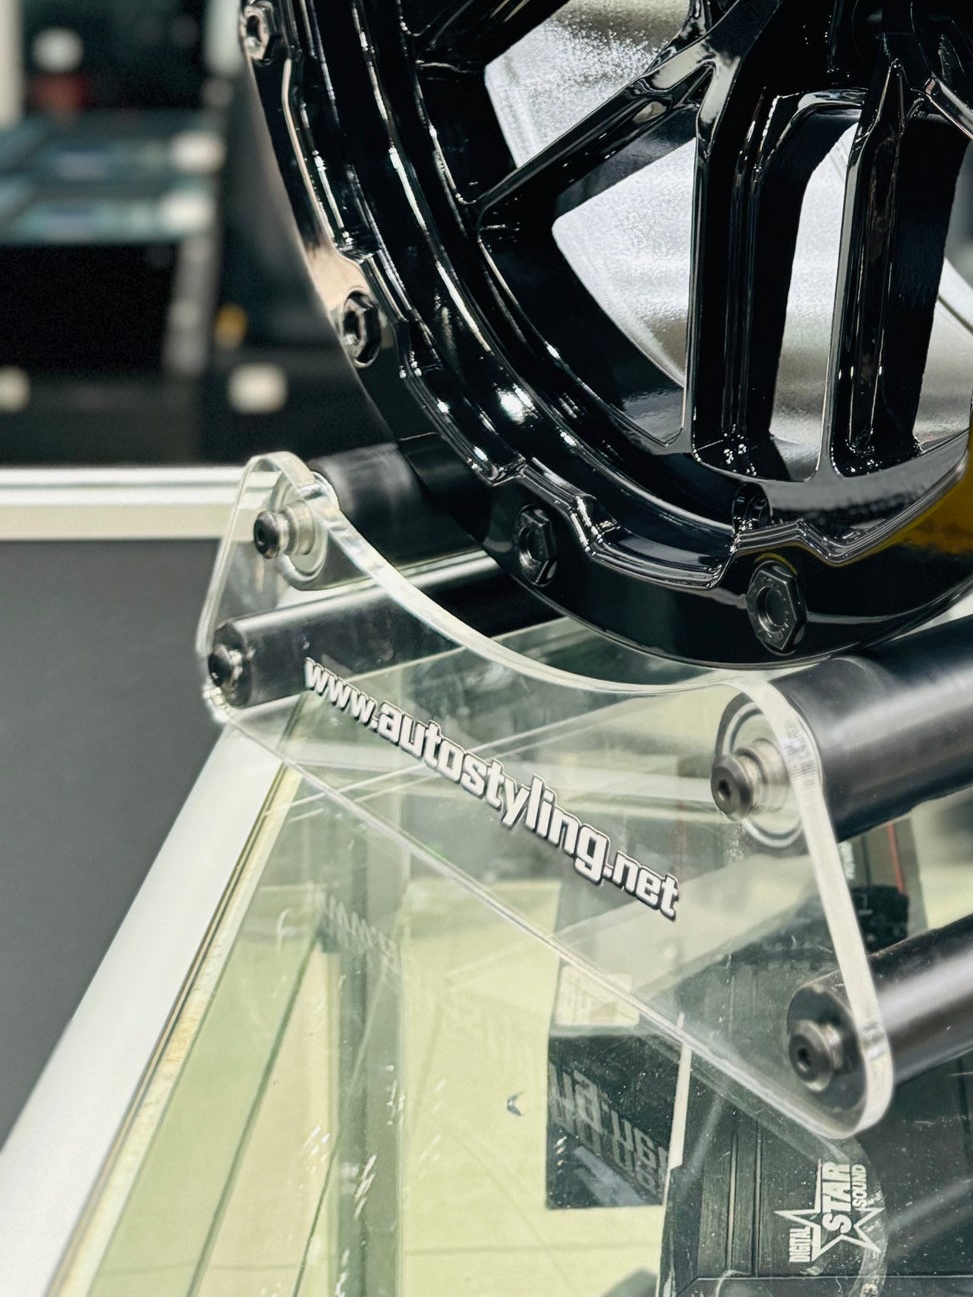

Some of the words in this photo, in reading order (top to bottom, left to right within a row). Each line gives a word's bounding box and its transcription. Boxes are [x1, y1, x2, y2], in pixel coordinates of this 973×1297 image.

[304, 657, 681, 921] www.autostyling.net
[821, 1161, 852, 1234] STAR
[852, 1163, 868, 1208] SOUND
[788, 1226, 812, 1263] DIGITAL
